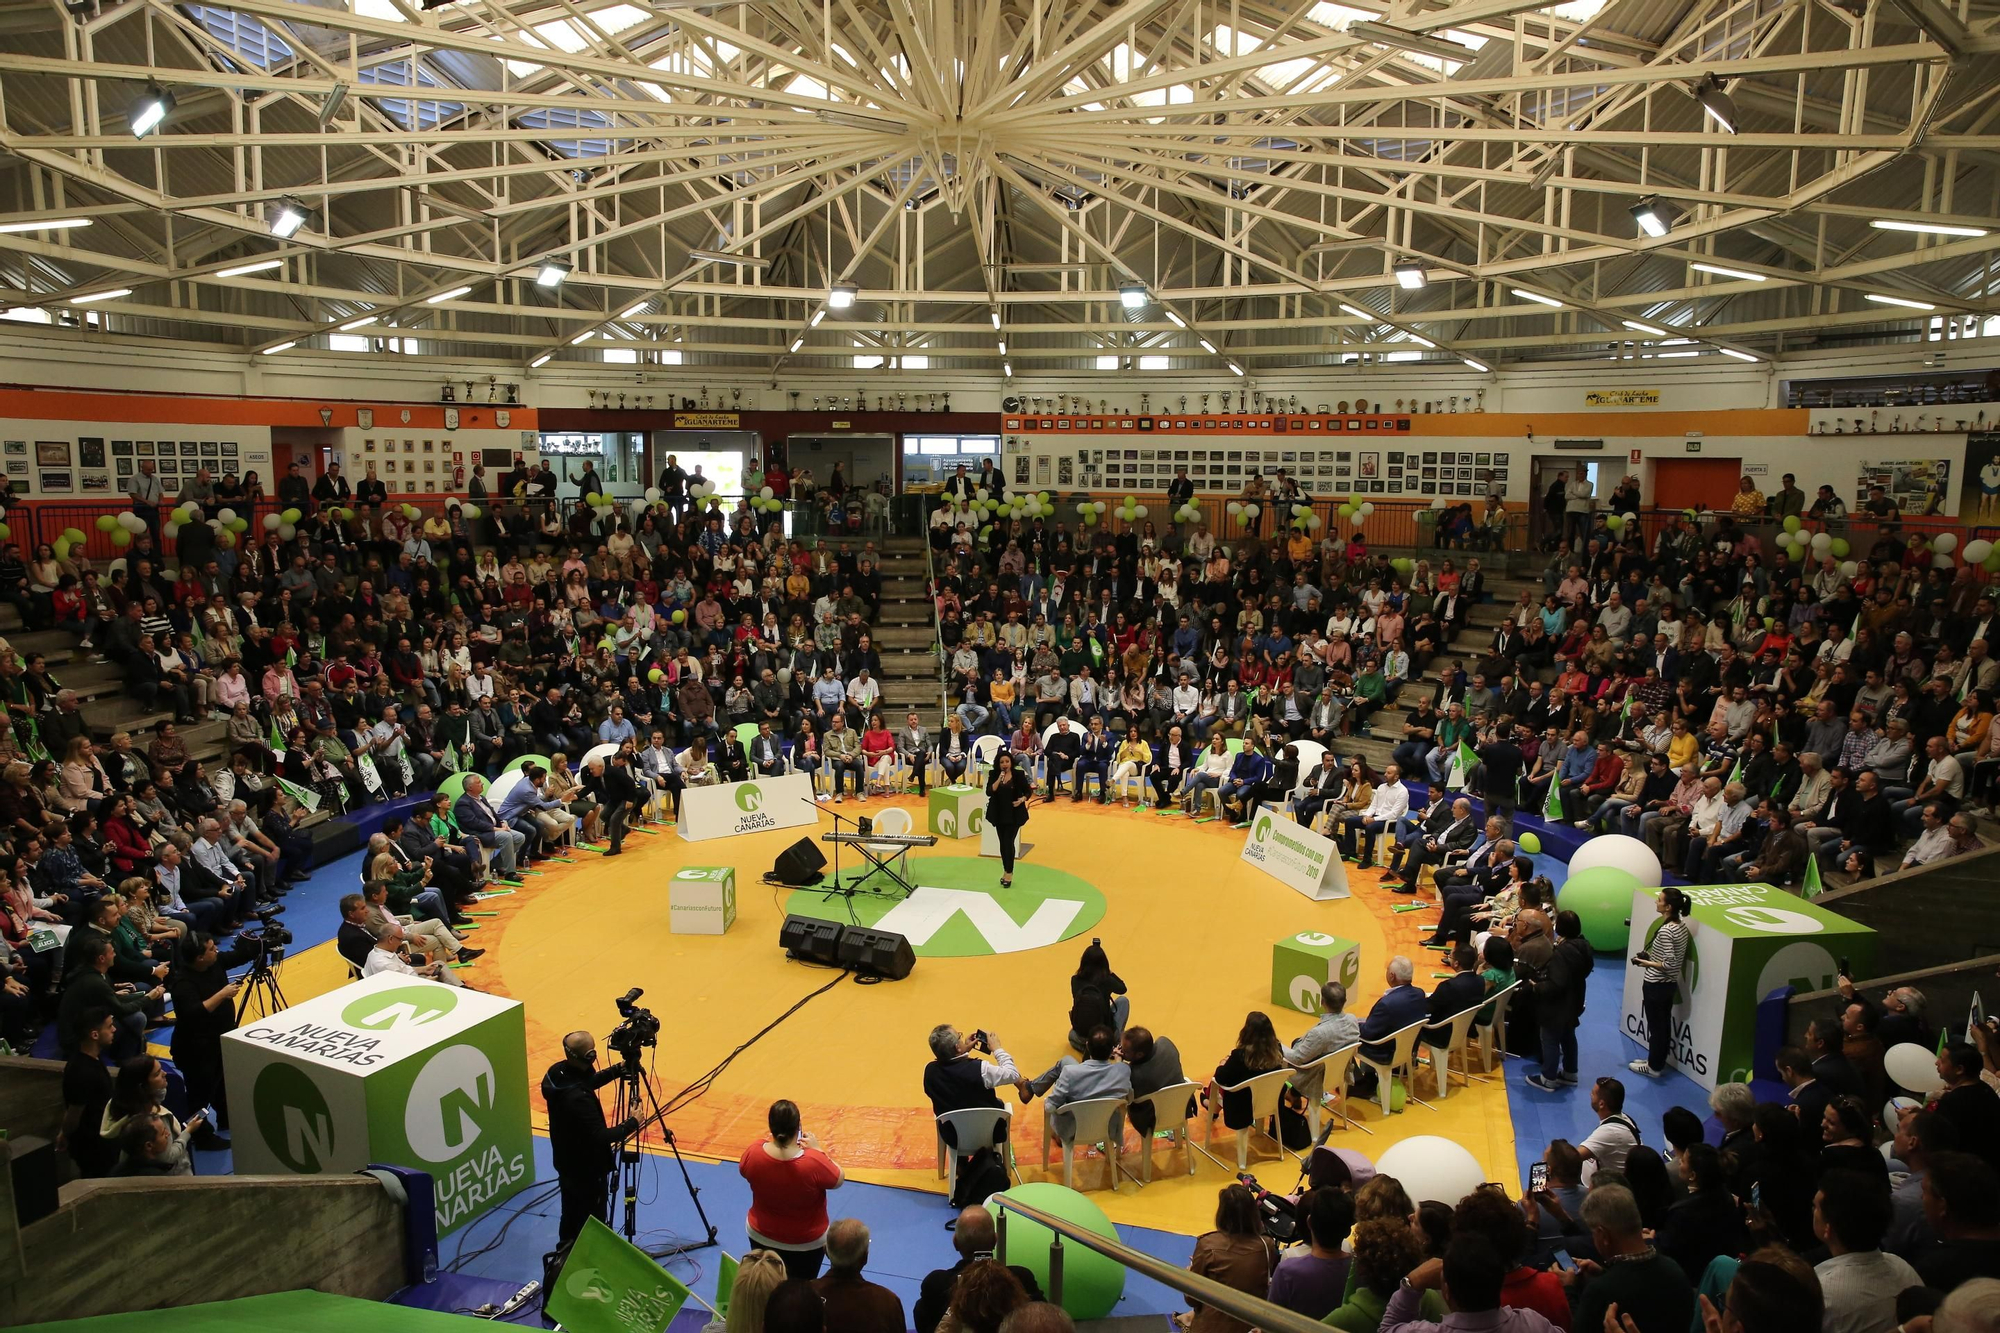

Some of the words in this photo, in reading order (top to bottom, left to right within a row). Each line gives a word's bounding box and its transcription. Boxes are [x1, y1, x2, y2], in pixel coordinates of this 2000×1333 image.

[1595, 396, 1659, 404] IGUAREME
[734, 818, 775, 833] CANARIAS
[740, 812, 767, 824] NUEVA
[1244, 847, 1266, 862] CANARIAS
[1250, 842, 1264, 853] NUEVA
[1272, 829, 1307, 856] Comprometidos
[1305, 847, 1316, 860] con
[1313, 852, 1325, 865] una
[1305, 864, 1320, 880] 2019
[1655, 885, 1769, 900] CANARI
[670, 904, 723, 912] #CanariasconFuturo
[289, 1023, 382, 1051] NUEVA
[1626, 1013, 1708, 1076] CARIAS
[244, 1028, 385, 1067] CANARIAS
[435, 1154, 526, 1235] NARIAS
